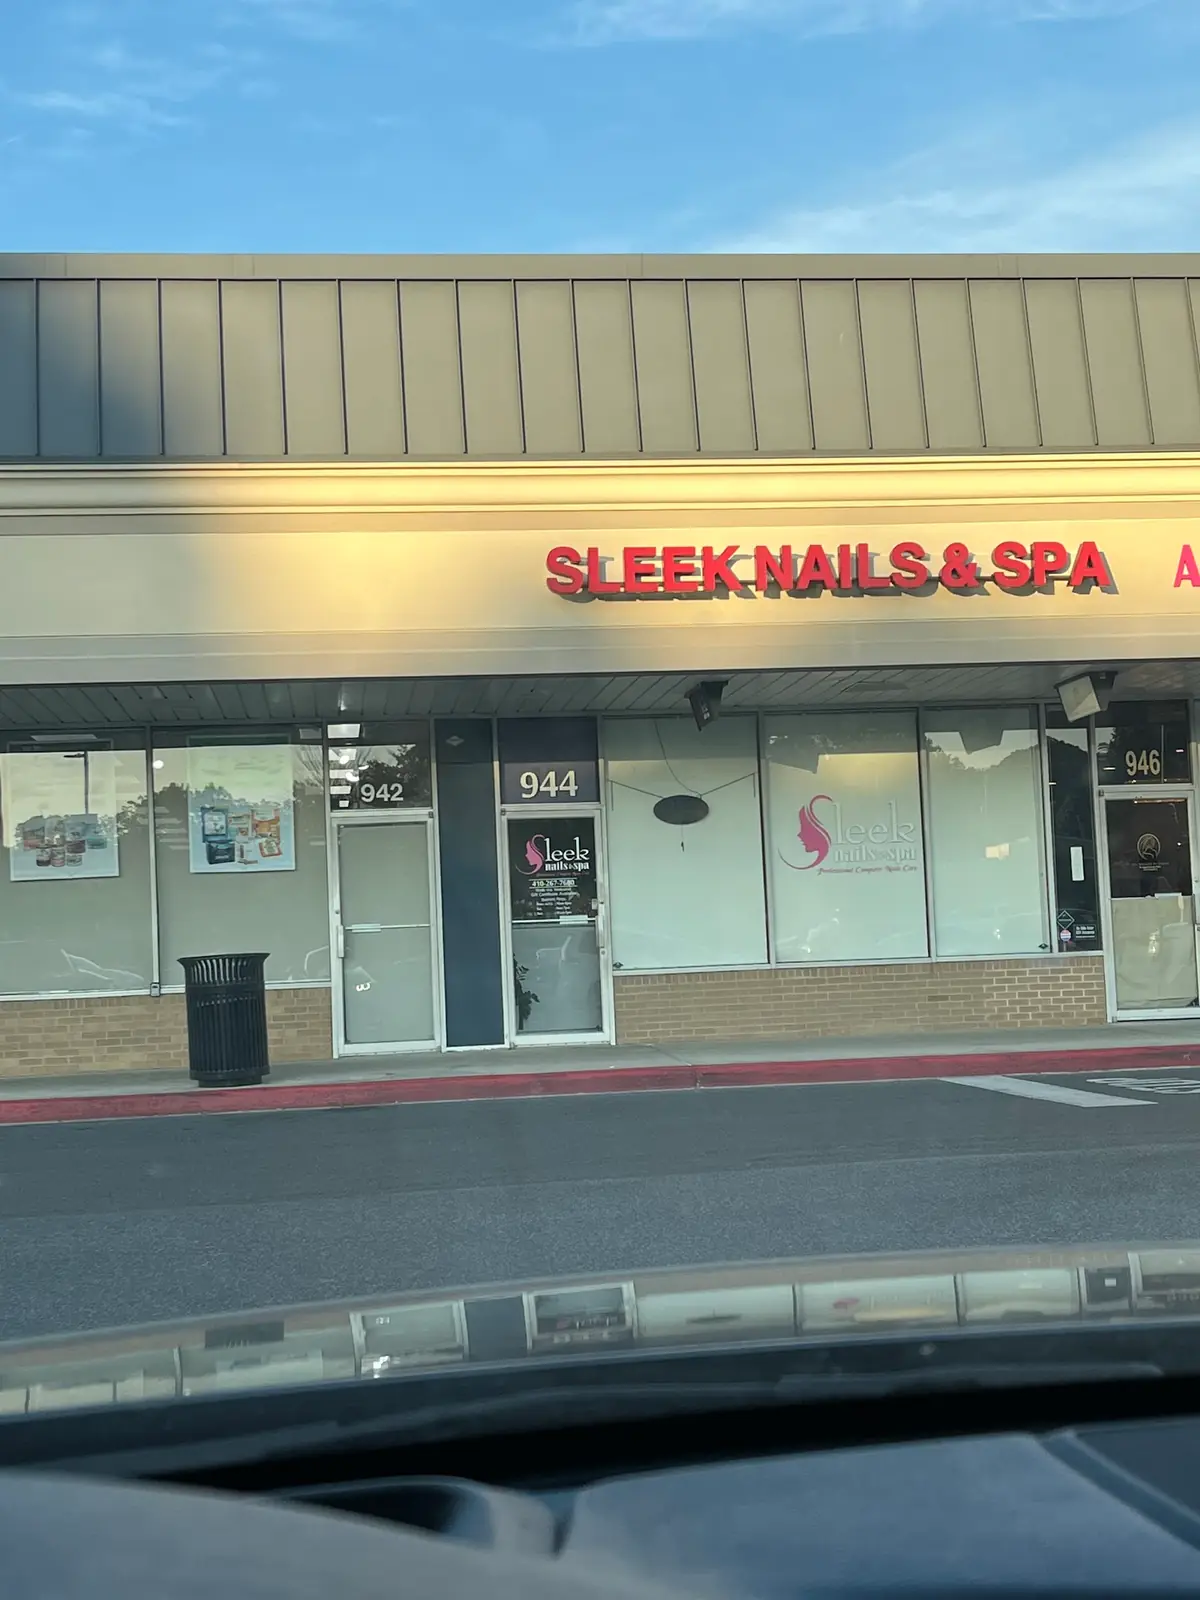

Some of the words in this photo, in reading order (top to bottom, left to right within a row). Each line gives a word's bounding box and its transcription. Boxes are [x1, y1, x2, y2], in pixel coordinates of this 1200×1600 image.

[546, 545, 743, 595] SLEEK
[754, 542, 928, 592] NAILS
[939, 542, 980, 588] &
[991, 540, 1111, 588] SPA
[1125, 749, 1161, 777] 946
[360, 782, 404, 803] 942
[520, 770, 578, 799] 944
